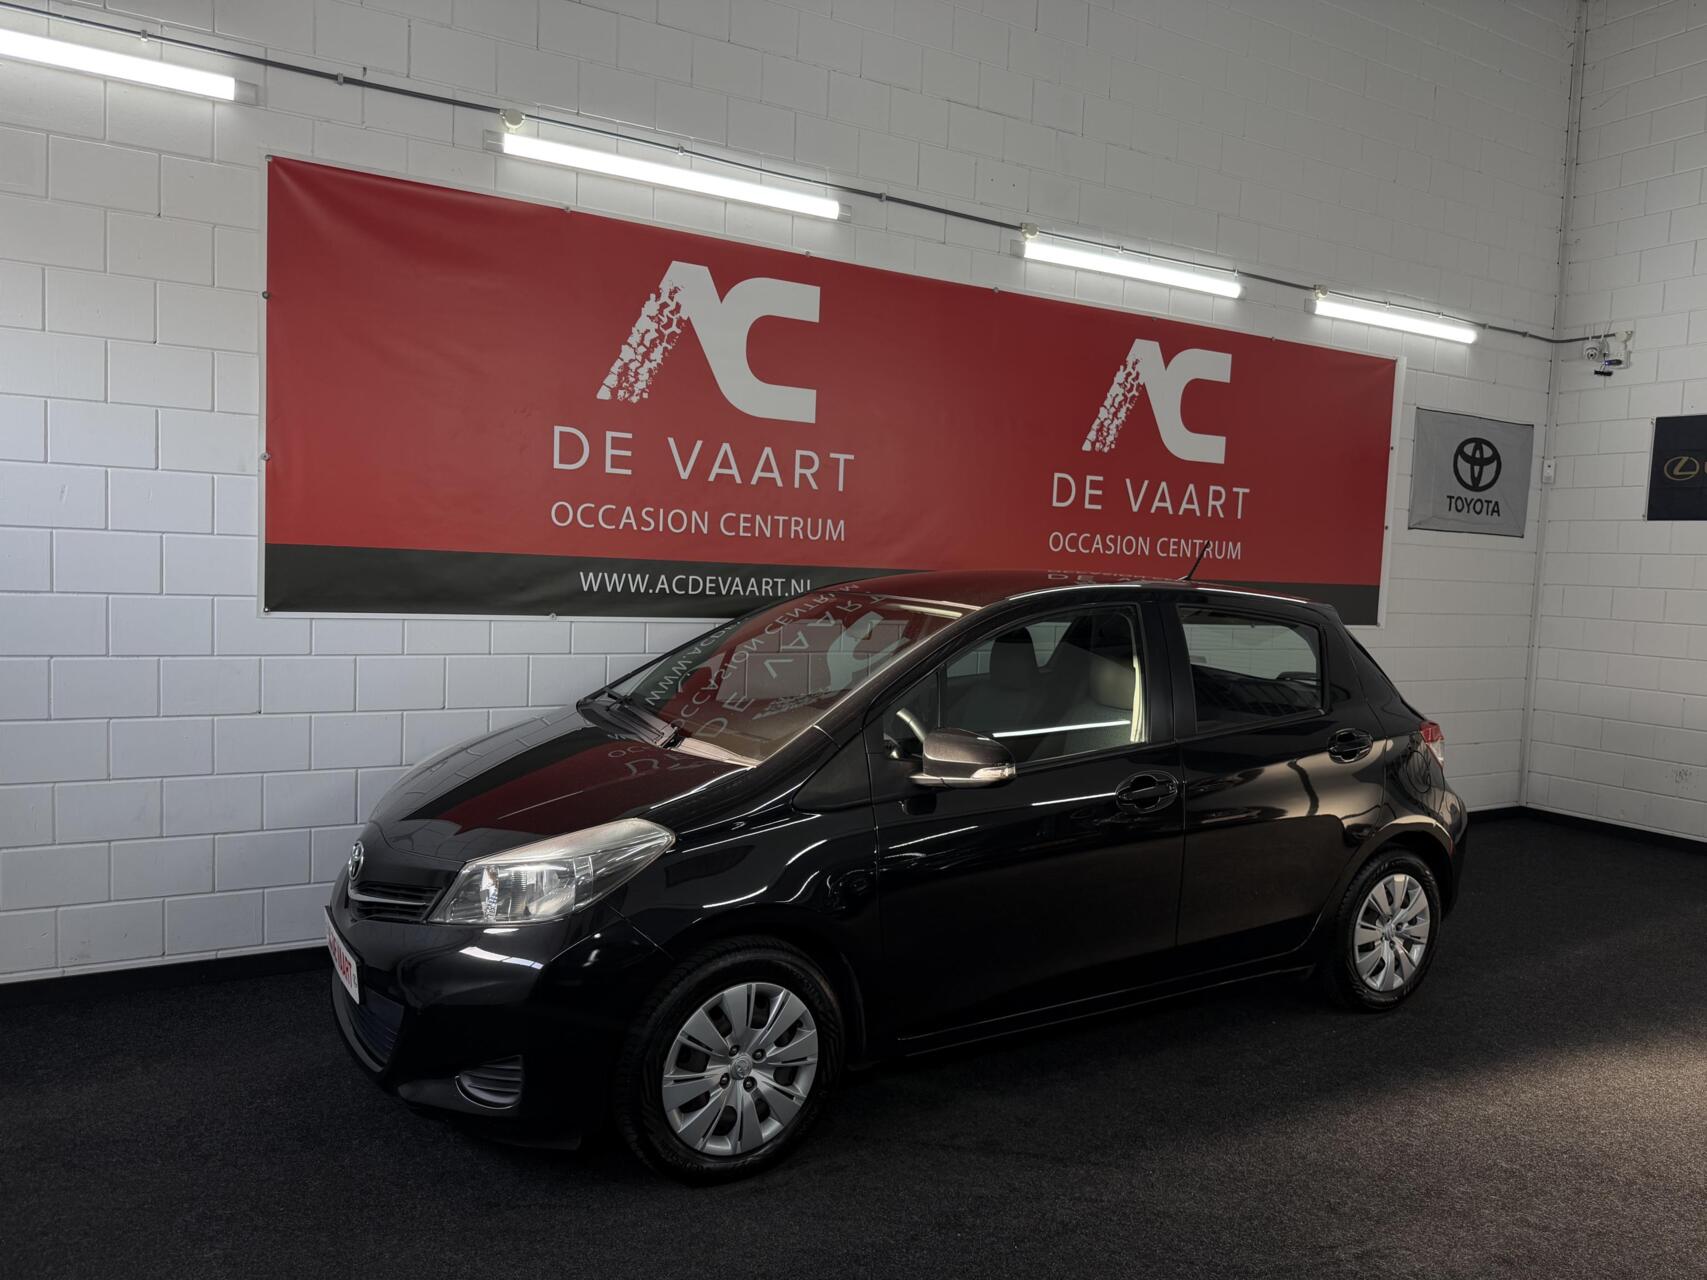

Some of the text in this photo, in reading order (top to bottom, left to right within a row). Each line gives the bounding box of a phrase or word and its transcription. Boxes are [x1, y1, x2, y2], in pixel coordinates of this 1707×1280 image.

[597, 260, 821, 424] AC
[1082, 338, 1233, 465] AC
[553, 425, 855, 492] DE VAART
[1052, 472, 1250, 520] DE VAART
[1446, 495, 1500, 517] TOYOTA
[551, 501, 845, 542] OCCASION CENTRUM
[1049, 531, 1242, 560] OCCASION CENTRUM
